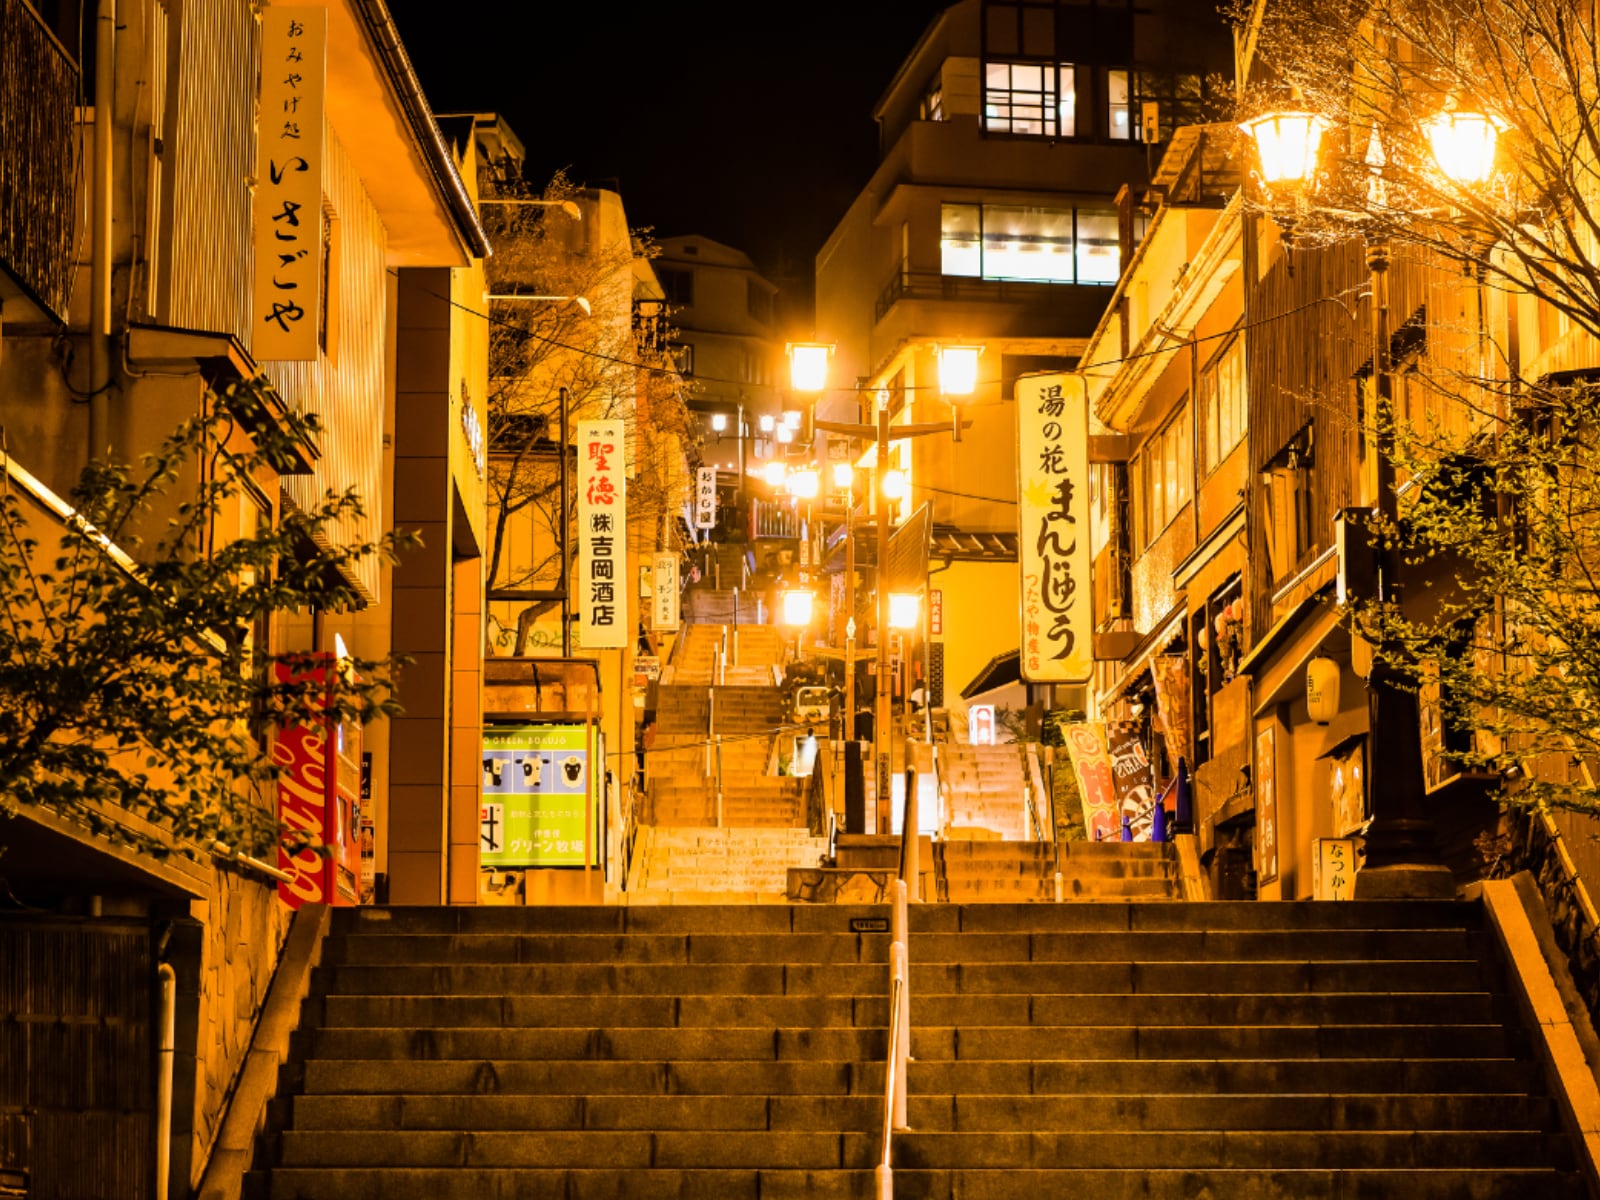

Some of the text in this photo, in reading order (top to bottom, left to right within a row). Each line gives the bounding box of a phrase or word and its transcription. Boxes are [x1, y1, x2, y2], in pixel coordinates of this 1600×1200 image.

[280, 18, 305, 141] おみやげ処
[264, 155, 310, 334] いさごや
[1037, 383, 1069, 474] 湯の花
[1024, 573, 1041, 672] つたや物産店
[1036, 478, 1077, 663] まんじゅう
[510, 838, 584, 855] グリーン牧場
